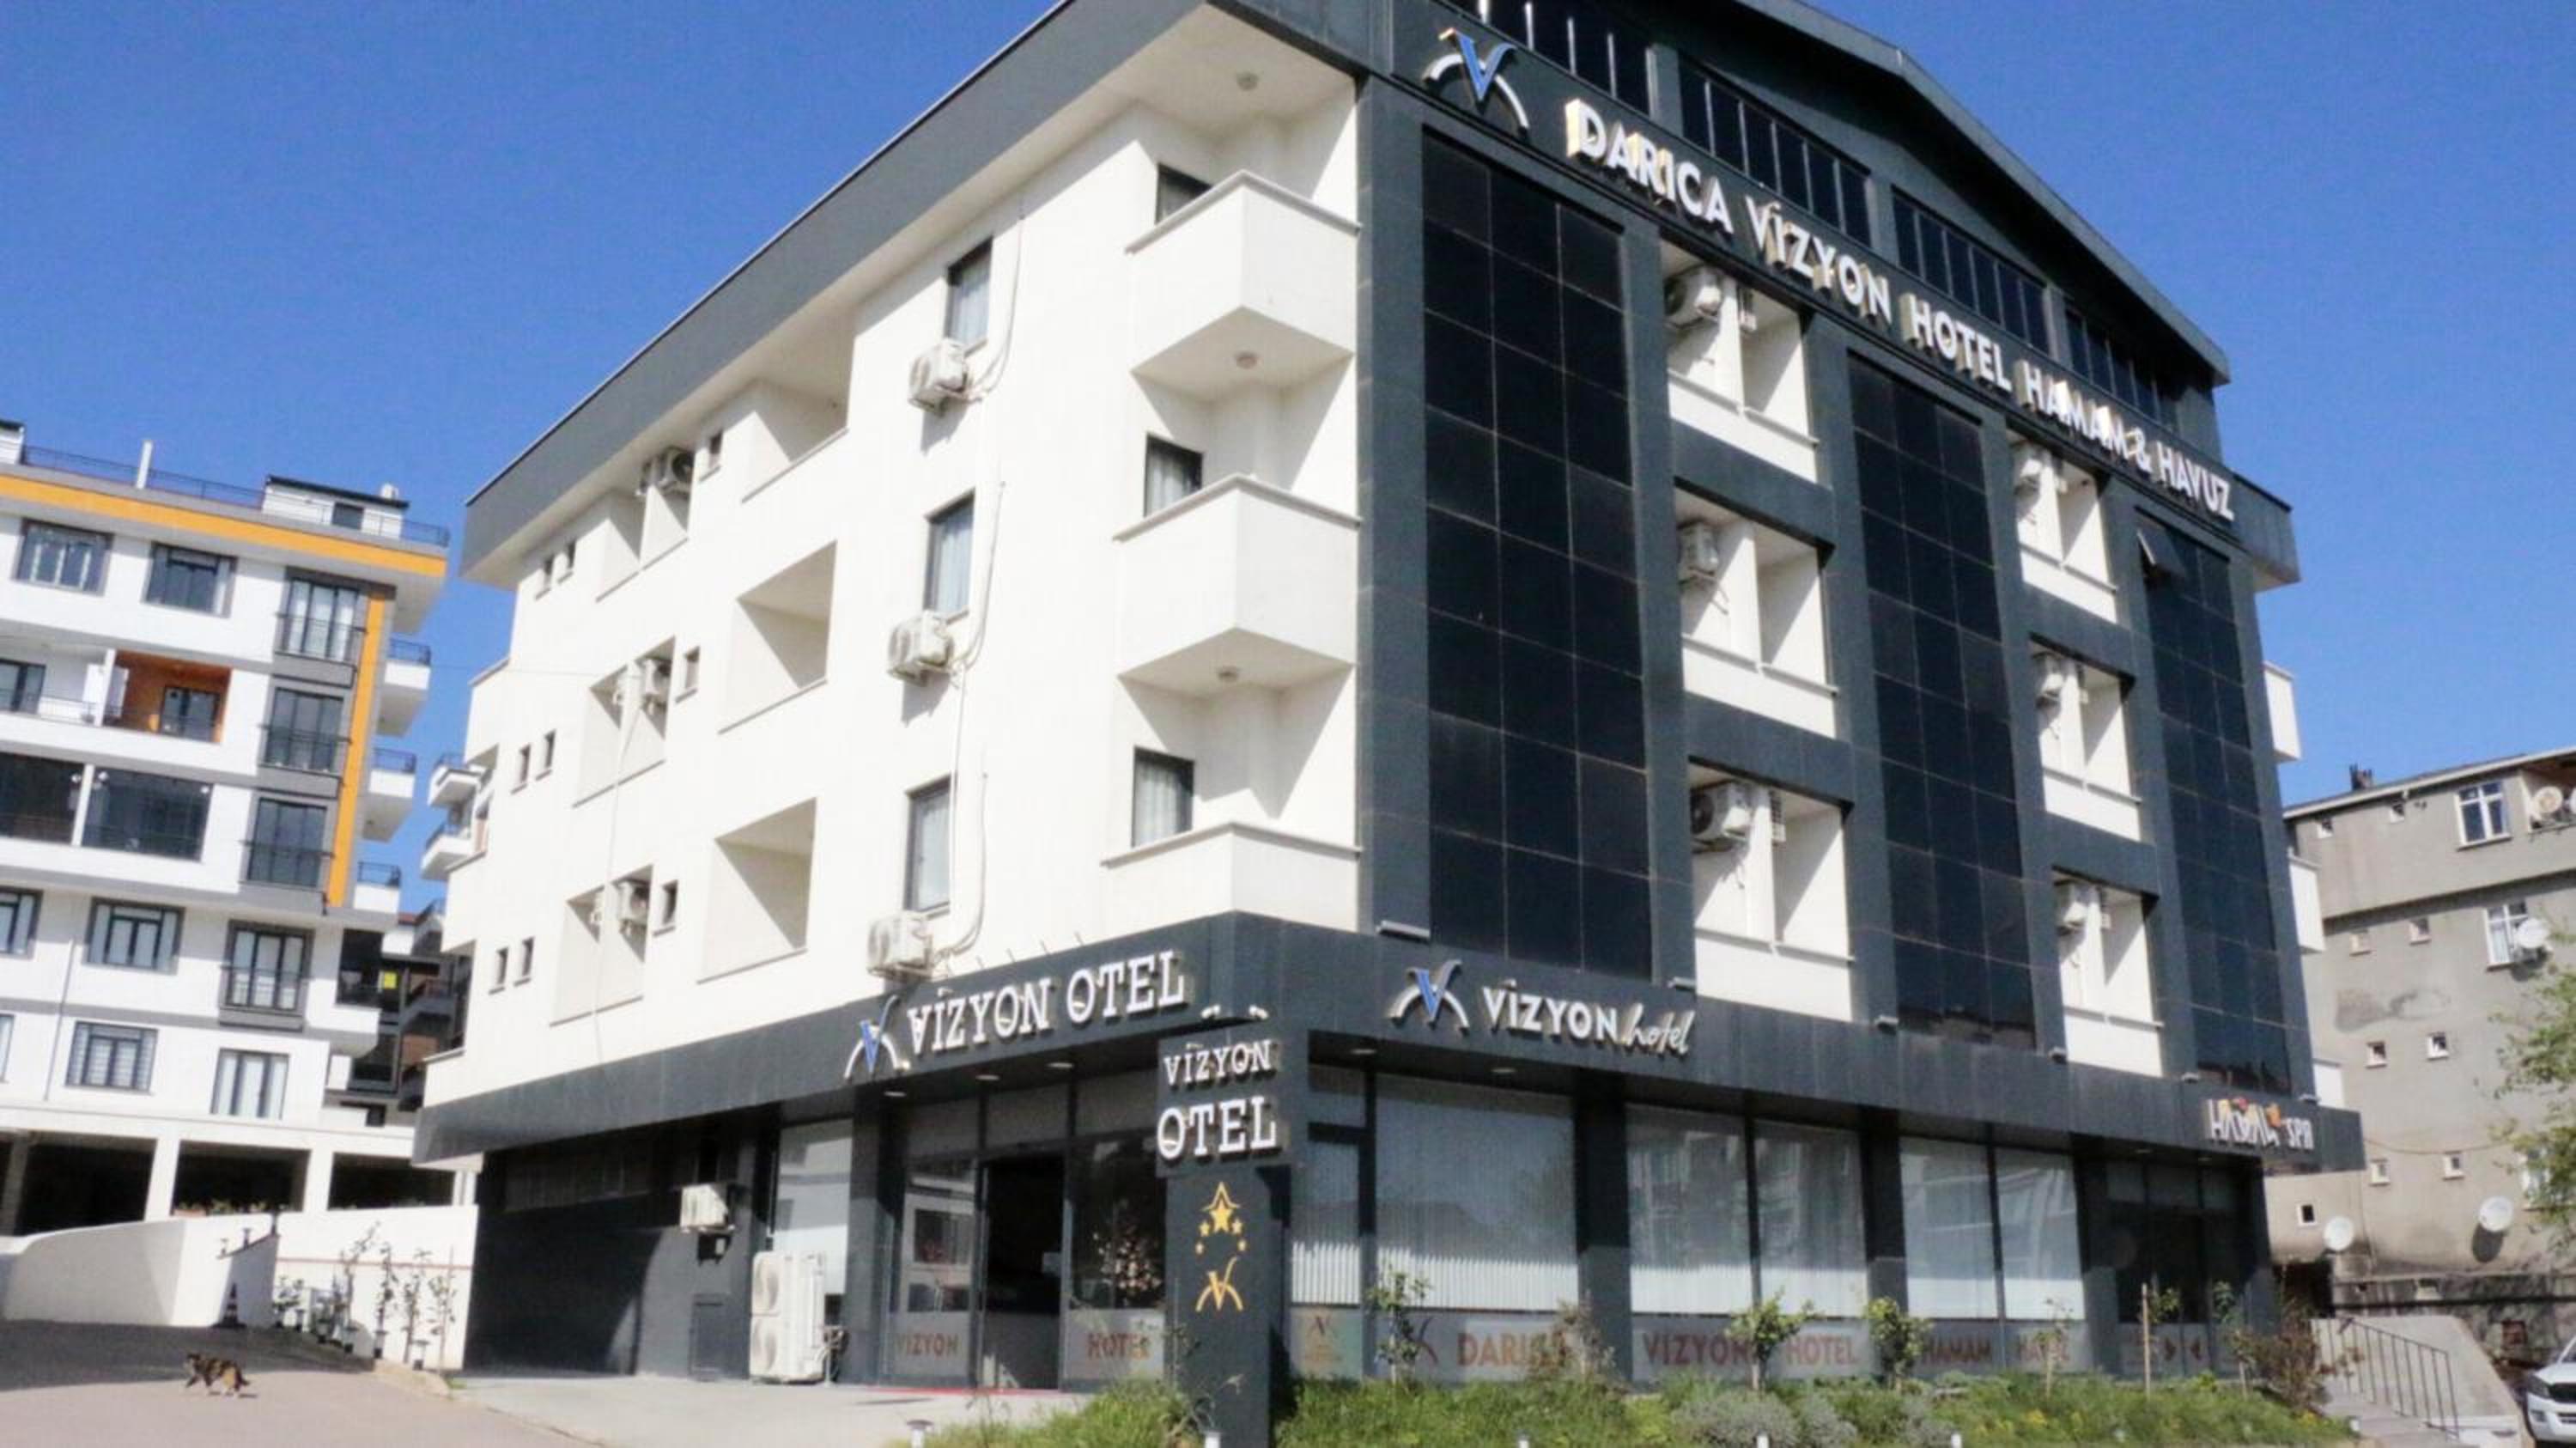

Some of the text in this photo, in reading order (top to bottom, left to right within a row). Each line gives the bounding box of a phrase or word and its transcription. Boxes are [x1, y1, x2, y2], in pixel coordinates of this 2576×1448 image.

[1565, 98, 1735, 234] DARICA
[1899, 291, 2012, 392] HOTEL
[2014, 359, 2130, 460] HAMAM
[2154, 439, 2235, 521] HAVUZ
[1066, 950, 1185, 1024] OTEL
[1621, 1003, 1696, 1056] hotel
[1157, 1096, 1277, 1160] OTEL
[1784, 1335, 1860, 1366] HOTEL
